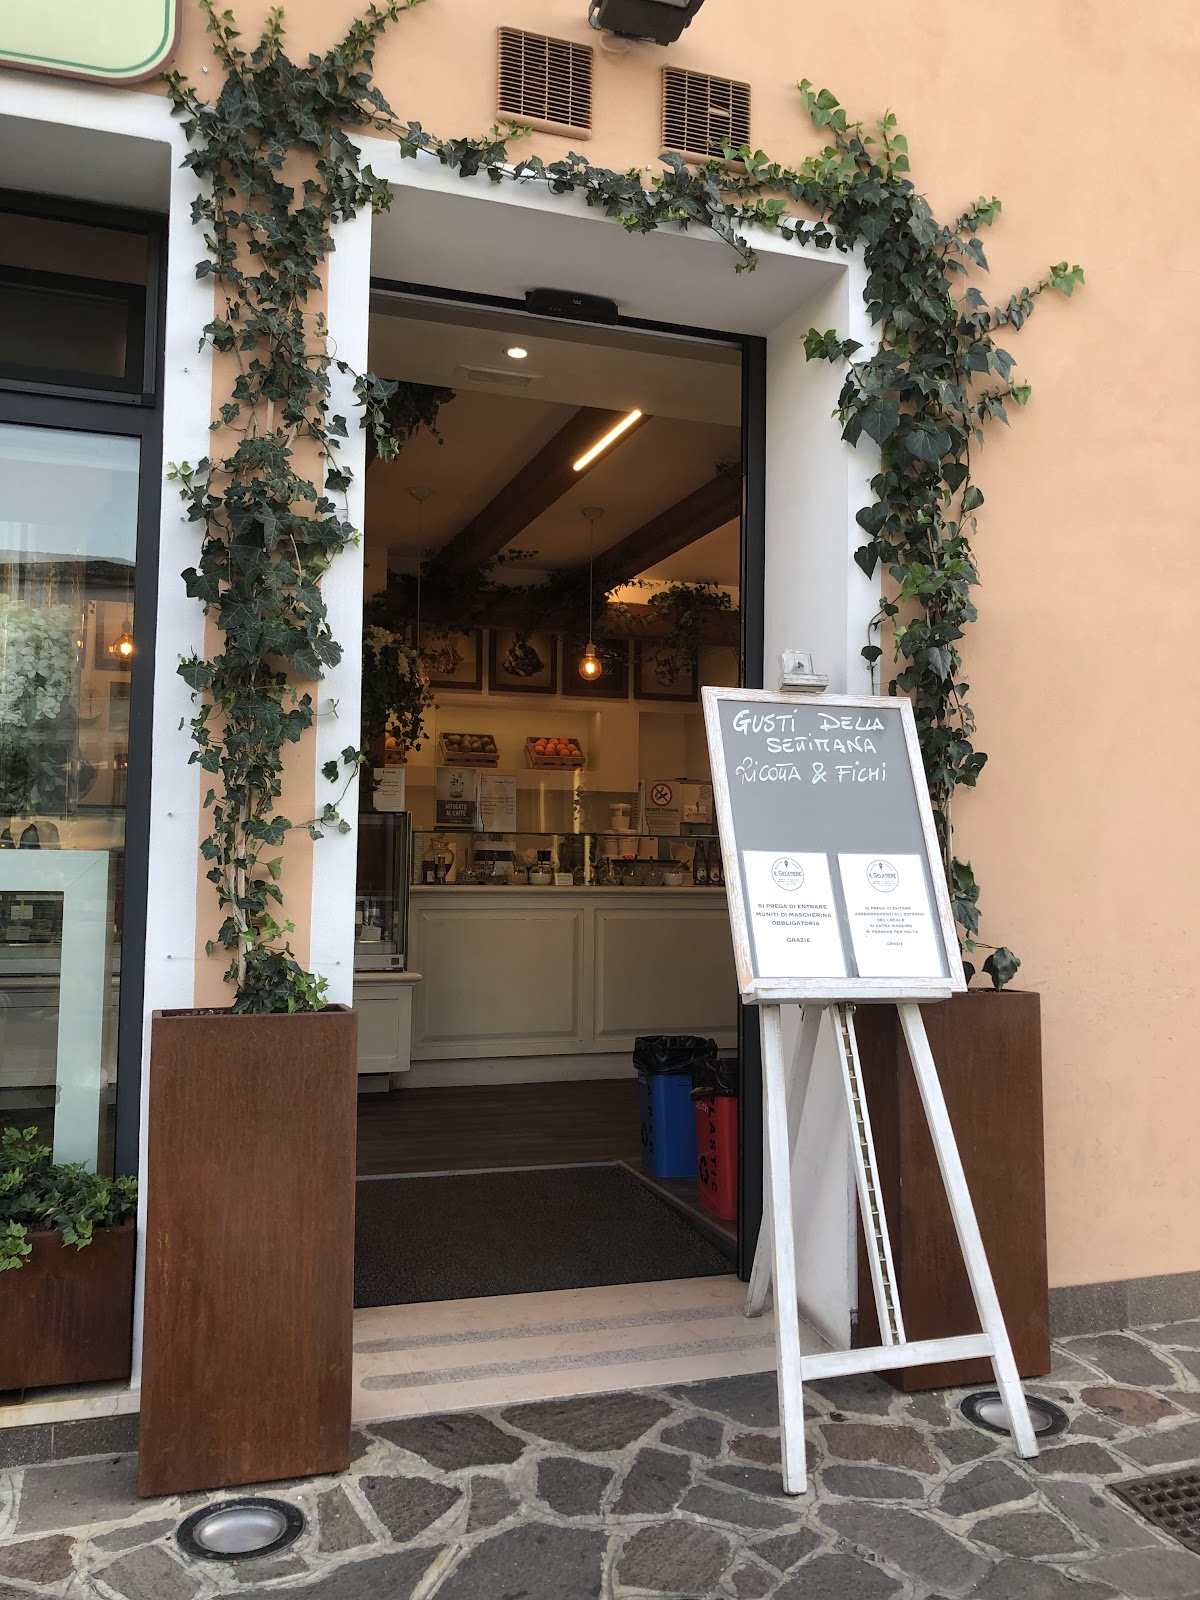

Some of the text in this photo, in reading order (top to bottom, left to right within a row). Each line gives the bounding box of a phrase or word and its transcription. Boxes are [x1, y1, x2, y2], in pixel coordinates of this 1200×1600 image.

[817, 712, 885, 732] DELLA
[811, 761, 827, 785] &
[834, 760, 886, 782] FICHI
